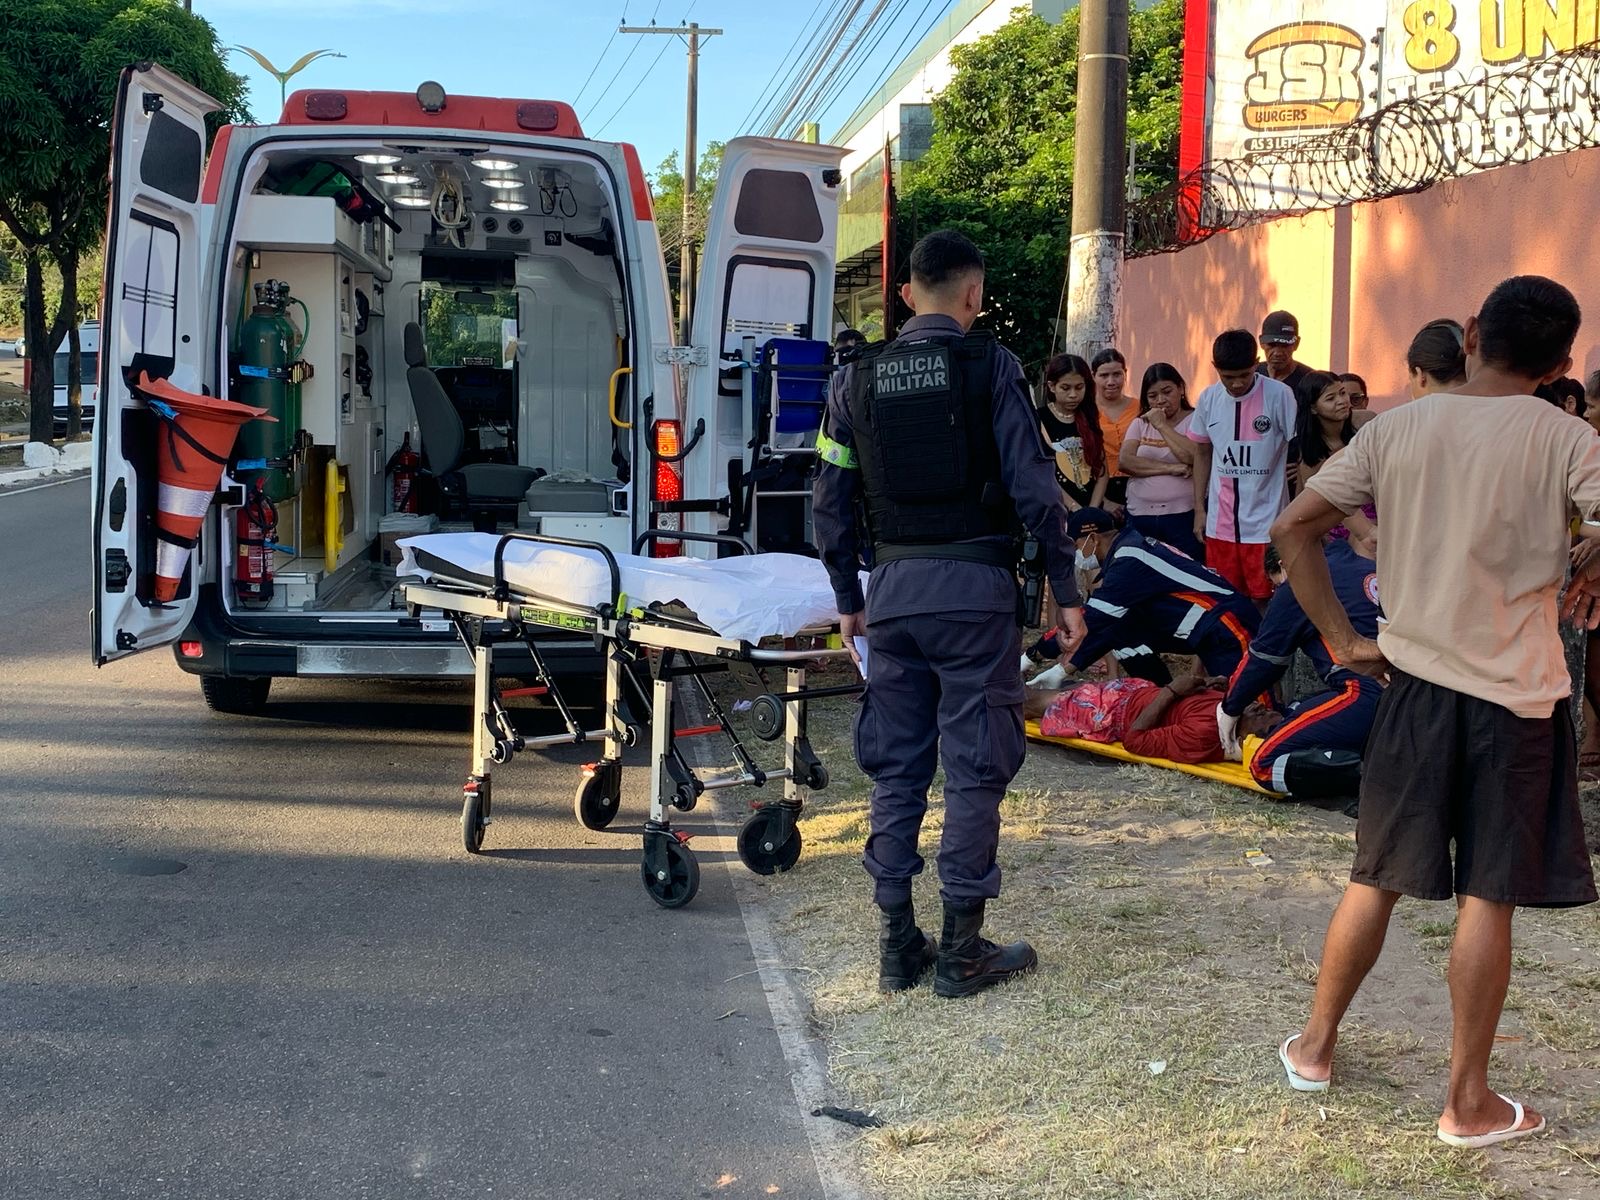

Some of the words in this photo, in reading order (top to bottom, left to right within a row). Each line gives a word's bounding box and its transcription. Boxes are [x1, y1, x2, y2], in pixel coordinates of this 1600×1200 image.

[1403, 0, 1460, 73] 8
[1244, 42, 1365, 104] JSK
[1255, 109, 1307, 123] BURGERS
[1387, 66, 1488, 126] TEM
[1250, 138, 1264, 151] AS
[1266, 137, 1274, 150] 3
[1440, 112, 1584, 170] PERTO
[876, 355, 945, 378] POLÍCIA
[877, 371, 947, 393] MILITAR
